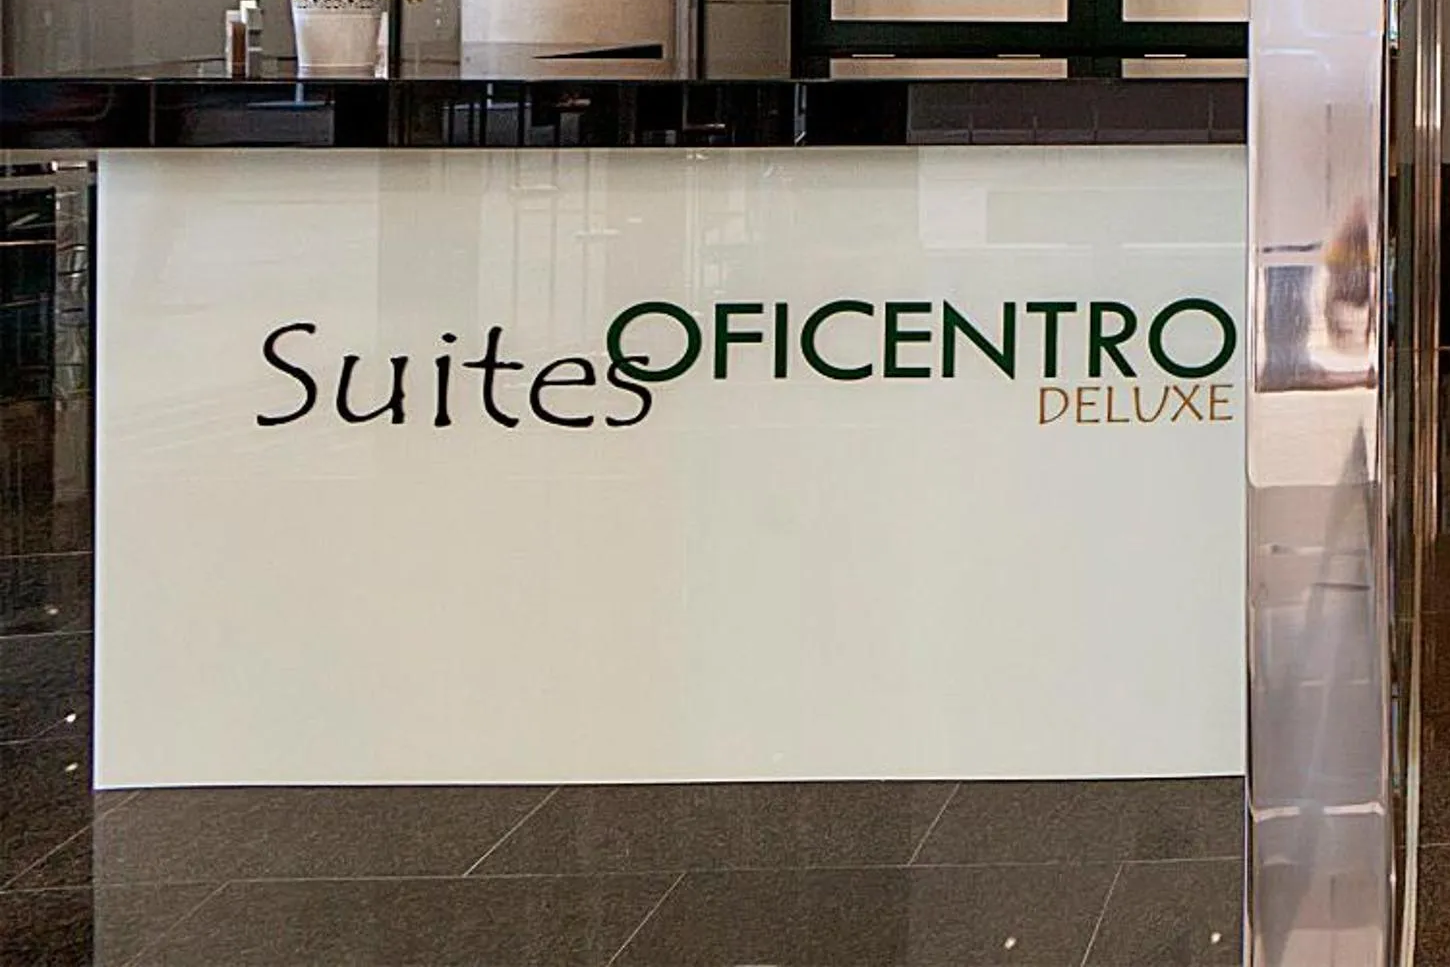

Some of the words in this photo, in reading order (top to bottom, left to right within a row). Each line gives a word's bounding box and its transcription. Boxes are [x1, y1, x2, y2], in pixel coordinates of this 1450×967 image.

[256, 322, 653, 429] Suites
[605, 298, 1237, 381] OFICENTRO
[1038, 384, 1234, 426] DELUXE
